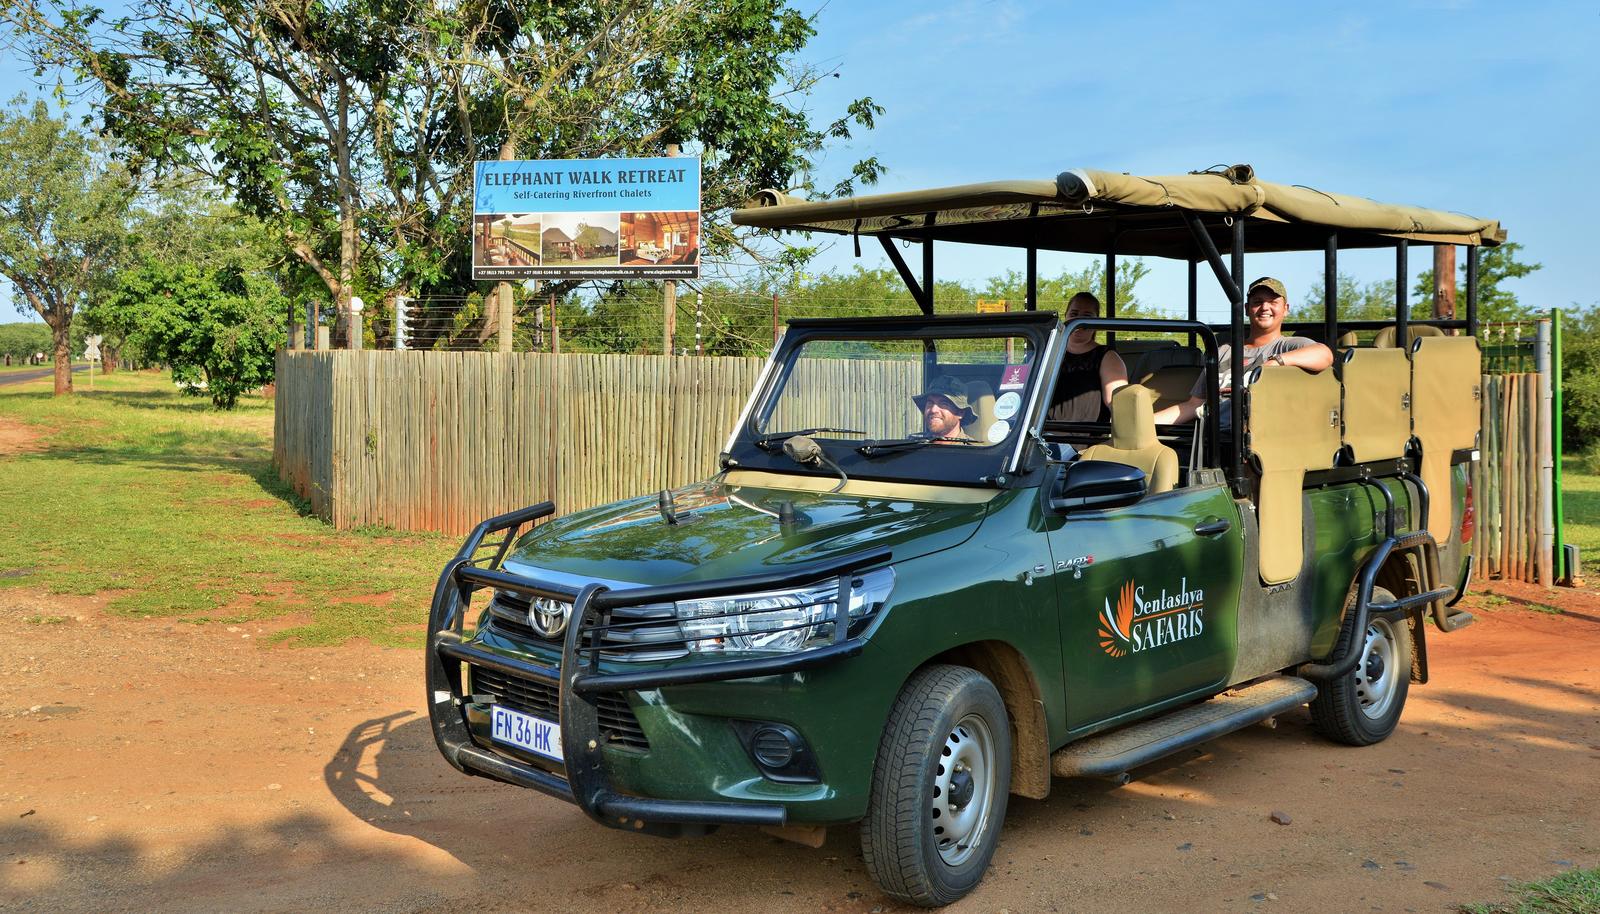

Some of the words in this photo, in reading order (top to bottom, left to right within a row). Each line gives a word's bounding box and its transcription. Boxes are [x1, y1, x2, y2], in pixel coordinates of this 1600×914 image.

[485, 171, 563, 186] ELEPHANT
[569, 170, 612, 185] WALK
[618, 169, 686, 183] RETREAT
[513, 190, 570, 200] Self-Catering
[573, 189, 617, 198] Riverfront
[619, 189, 652, 198] Chalets
[1134, 577, 1204, 617] Sentashya
[1132, 608, 1204, 653] SAFARIS
[496, 711, 512, 739] FN
[516, 716, 531, 745] 36
[535, 722, 551, 752] HK
